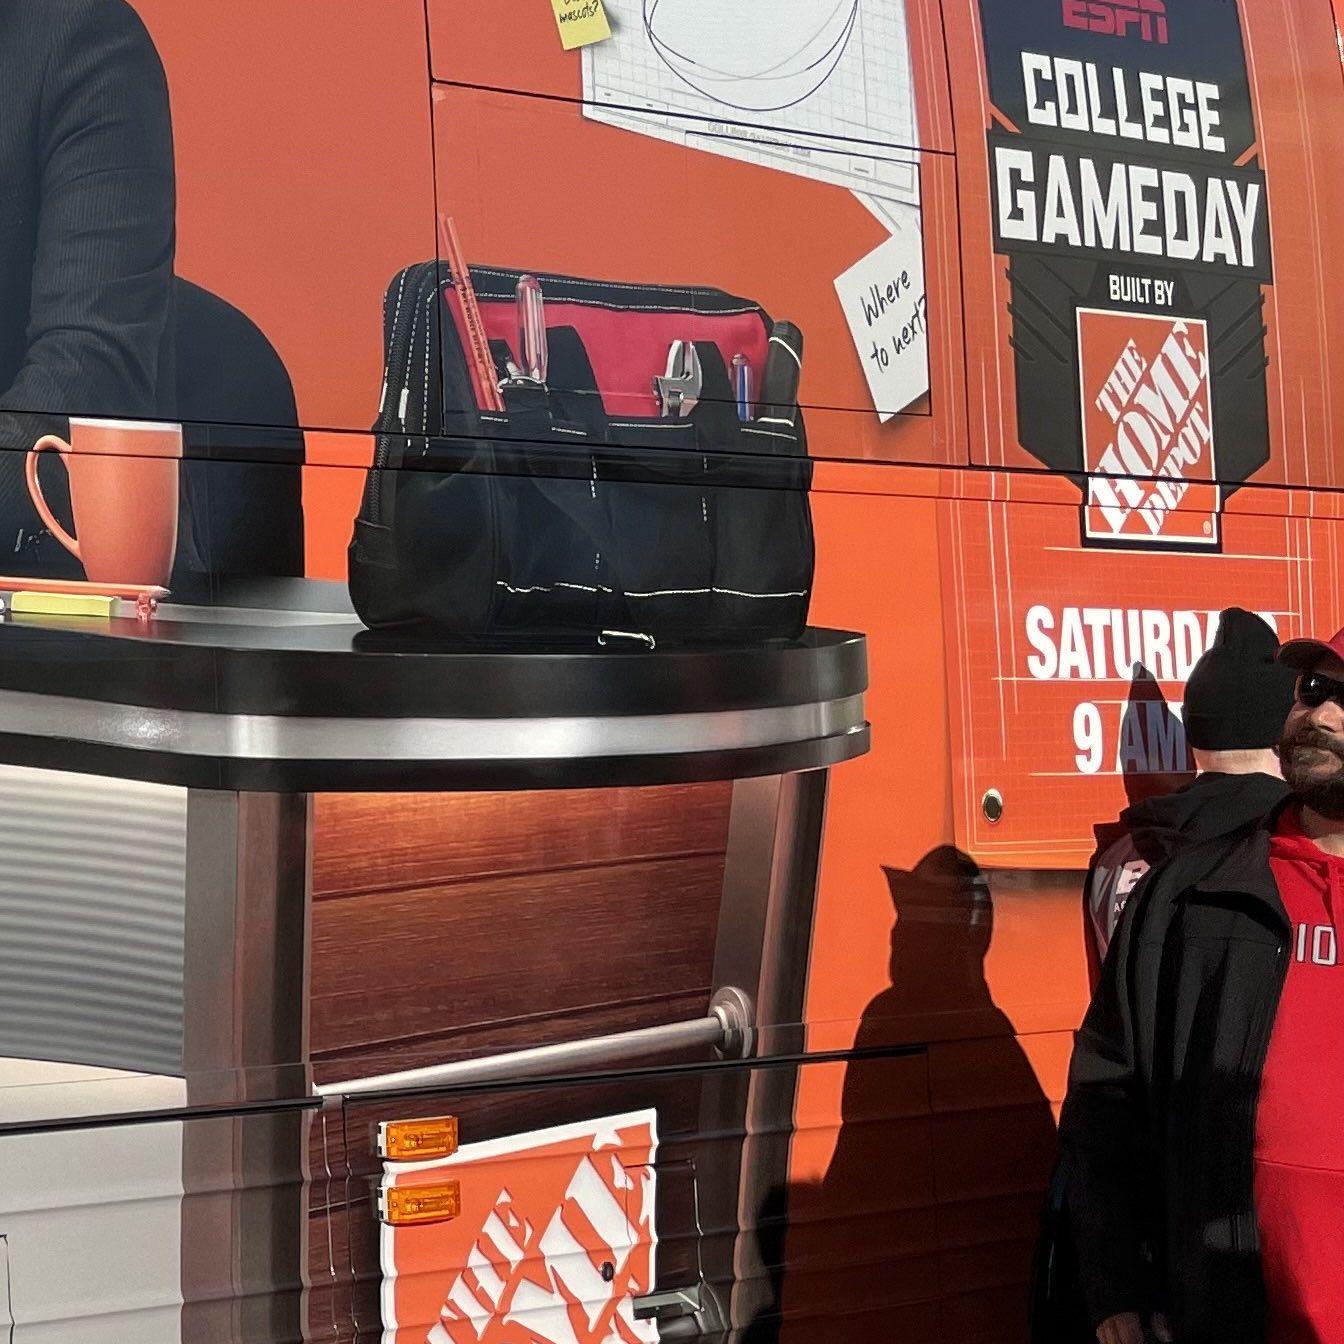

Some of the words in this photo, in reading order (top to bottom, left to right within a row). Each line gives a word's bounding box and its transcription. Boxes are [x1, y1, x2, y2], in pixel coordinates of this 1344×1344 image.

[559, 0, 599, 23] mascots?
[1020, 51, 1226, 153] COLLEGE
[994, 146, 1260, 267] GAMEDAY
[860, 270, 911, 327] Where
[1108, 274, 1151, 303] BUILT
[1154, 280, 1174, 306] BY
[870, 341, 889, 373] to
[1094, 337, 1148, 424] THE
[1091, 319, 1208, 534] HOME
[1137, 400, 1211, 536] DEPOT
[1025, 605, 1278, 680] SATURD
[1072, 702, 1103, 773] 9
[1115, 699, 1189, 772] AM
